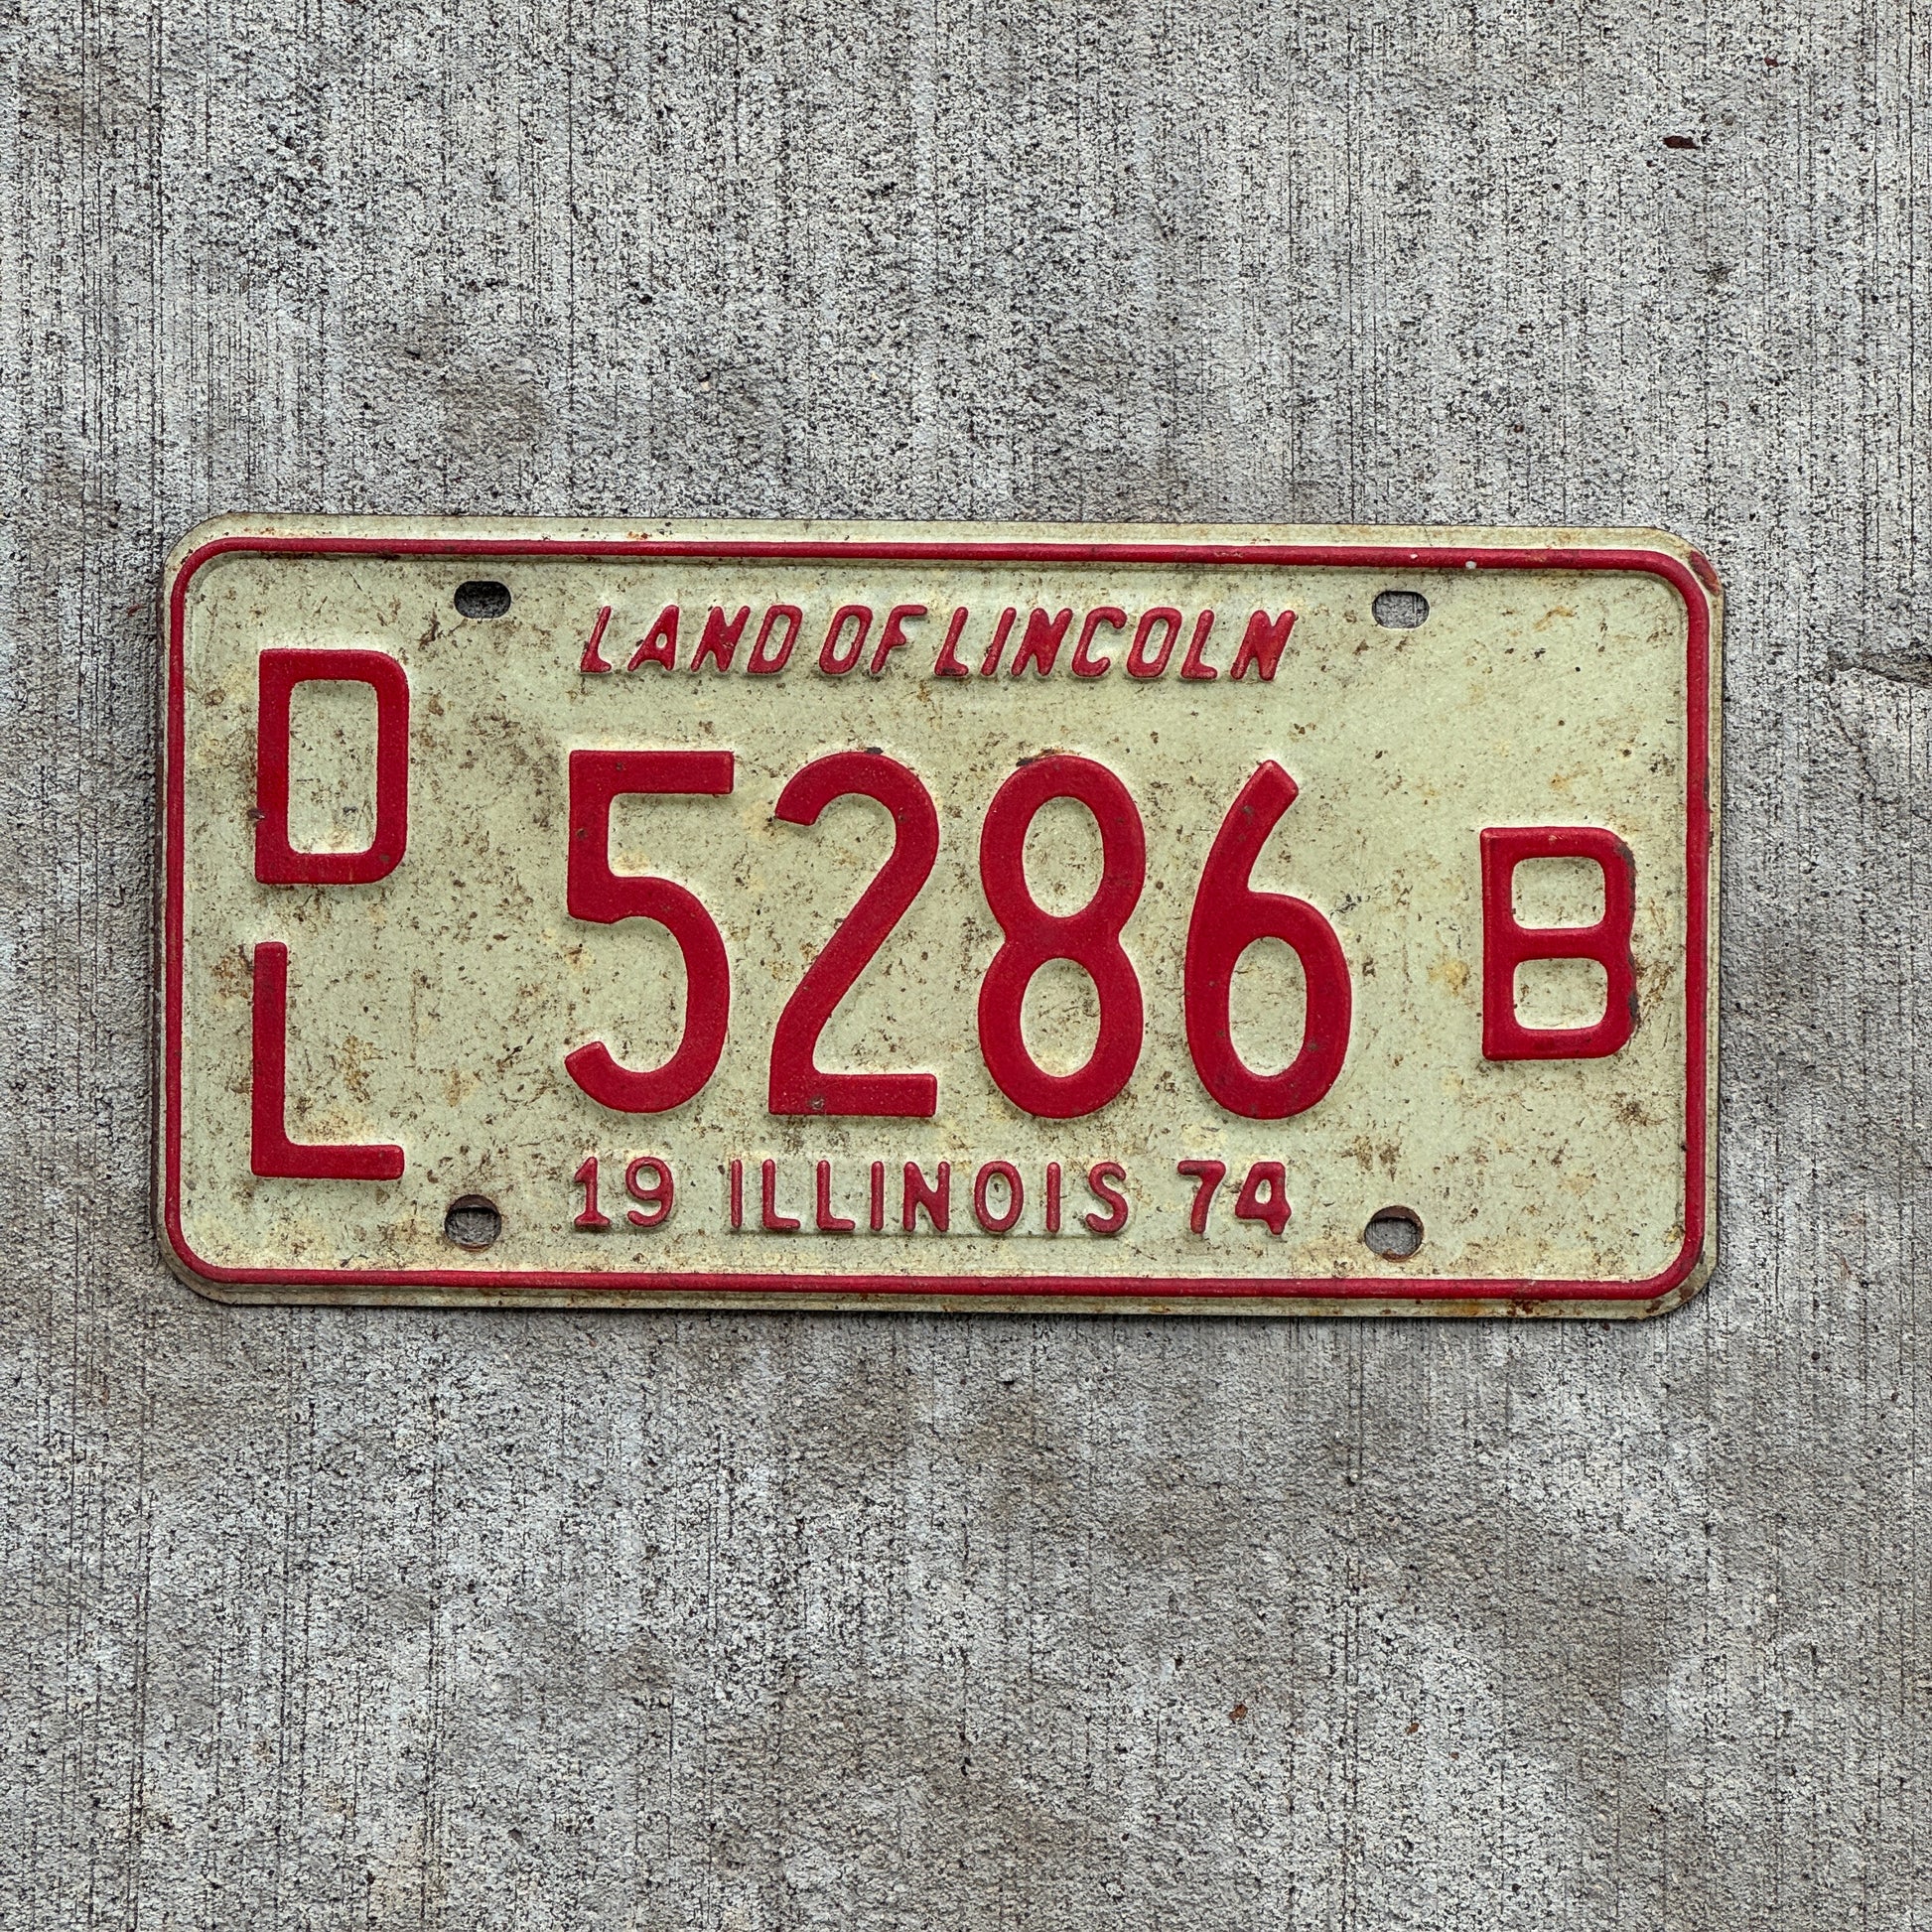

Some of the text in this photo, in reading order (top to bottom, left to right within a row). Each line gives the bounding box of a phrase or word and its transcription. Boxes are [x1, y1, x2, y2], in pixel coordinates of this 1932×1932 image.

[581, 604, 1297, 682] LAND OF LINCOLN
[564, 749, 1352, 1121] 5286
[1479, 826, 1640, 1063] B
[573, 1156, 1293, 1237] 19 ILLINOIS 74
